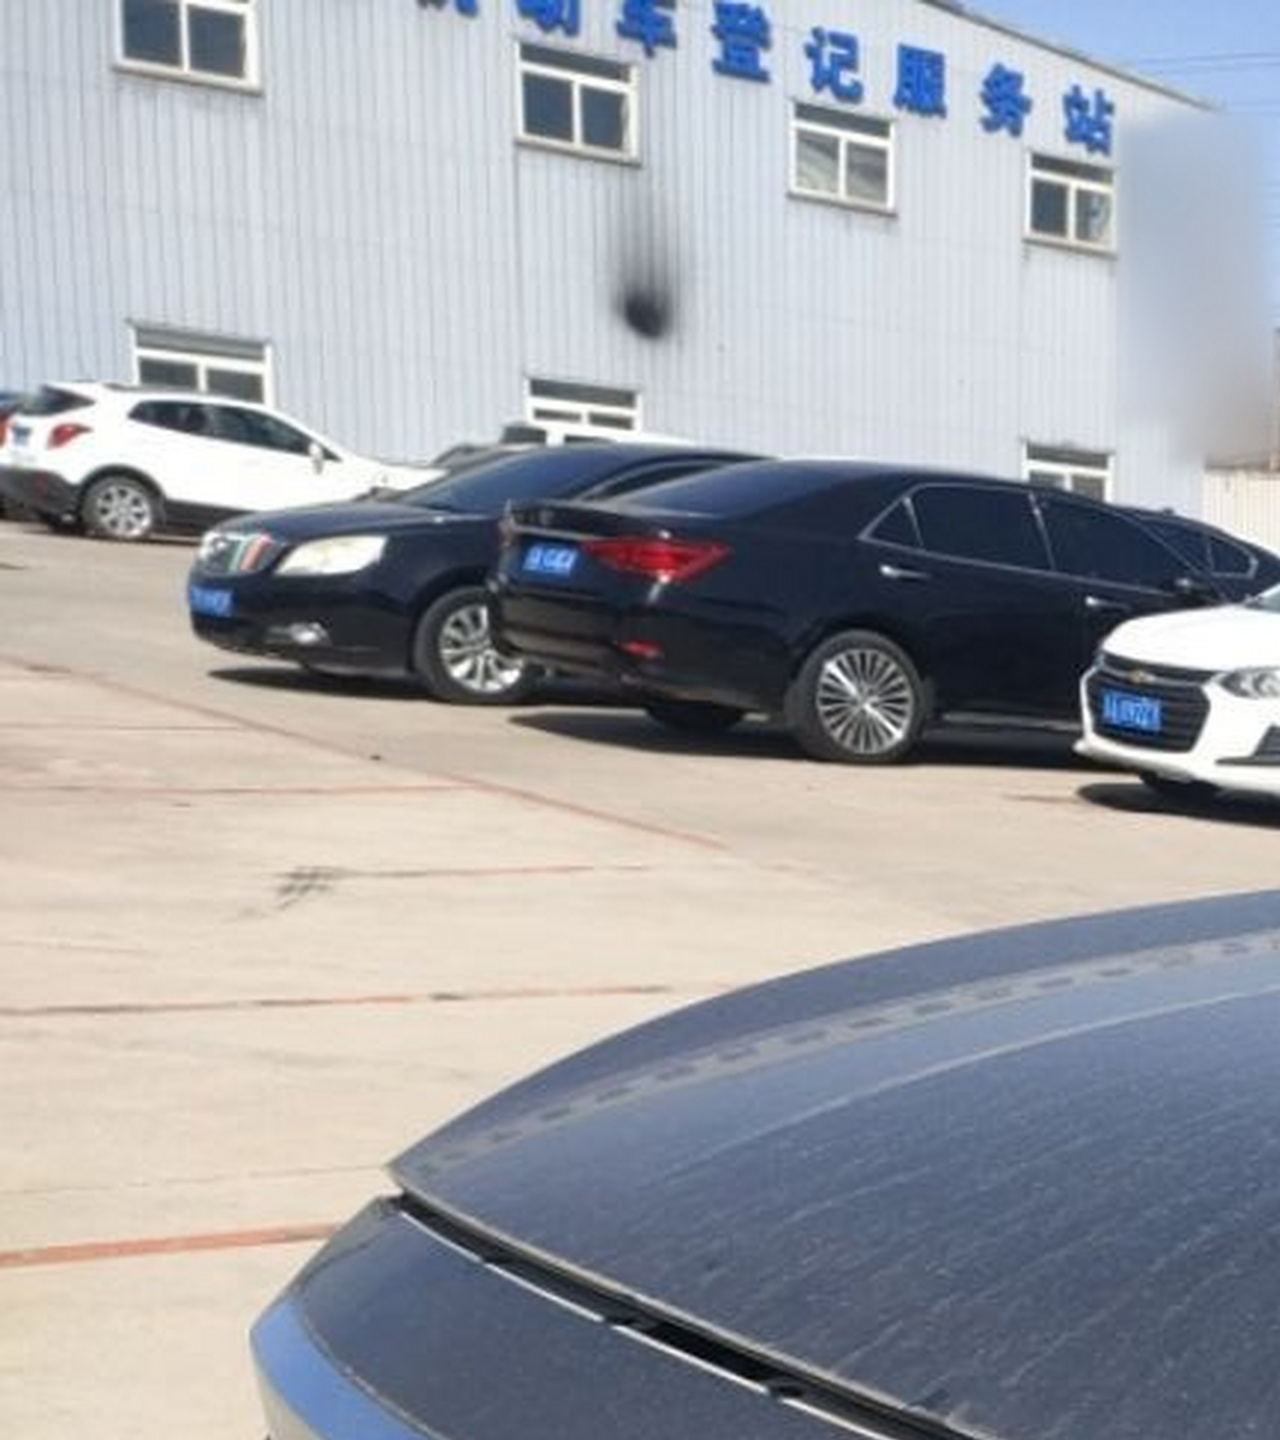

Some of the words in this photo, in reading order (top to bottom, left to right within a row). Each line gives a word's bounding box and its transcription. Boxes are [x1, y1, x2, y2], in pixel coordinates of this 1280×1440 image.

[417, 0, 1114, 154] 车登记服务站
